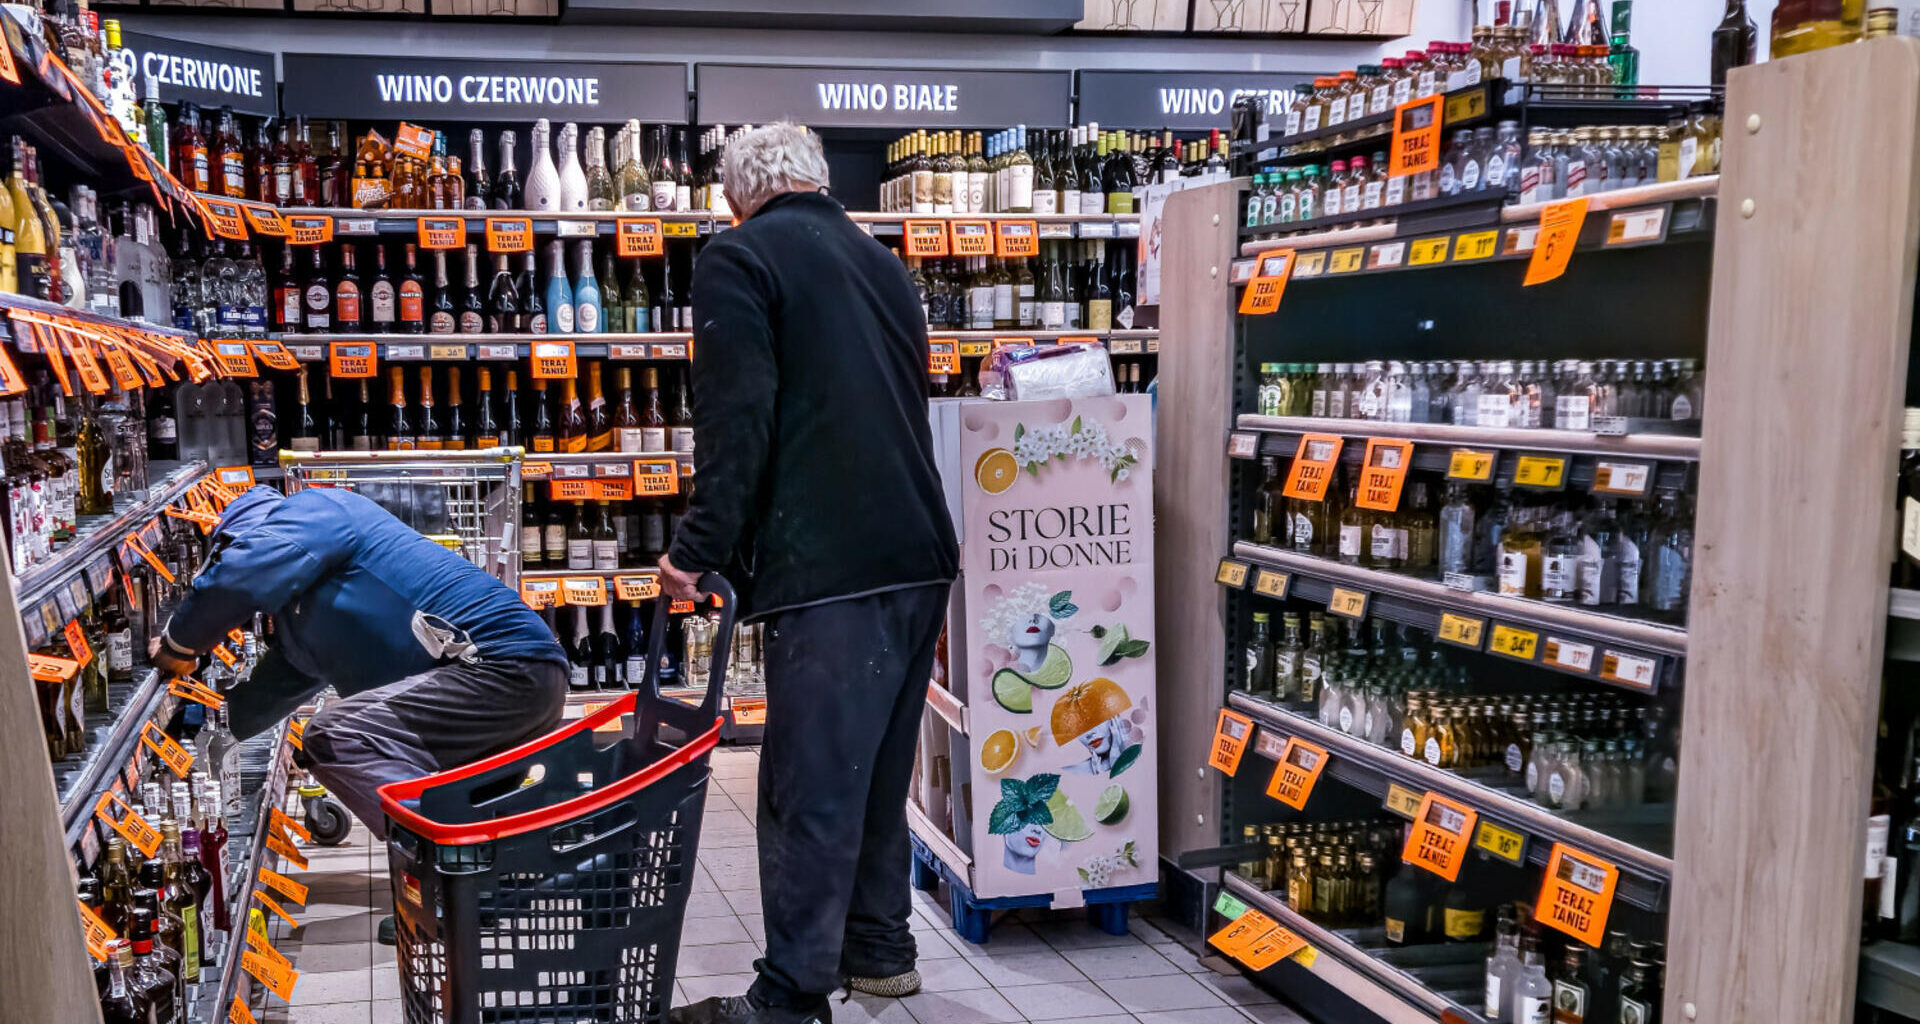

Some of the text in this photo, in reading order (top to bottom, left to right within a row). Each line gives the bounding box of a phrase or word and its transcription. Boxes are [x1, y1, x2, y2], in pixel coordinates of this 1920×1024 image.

[143, 52, 263, 97] CZERWONE
[377, 75, 599, 104] WINO CZERWONE
[818, 83, 958, 111] WINO BIAŁE
[1160, 88, 1225, 115] WINO
[643, 476, 669, 484] TERAZ
[644, 484, 670, 492] TANIEJ
[988, 503, 1131, 542] STORIE
[991, 540, 1131, 571] Di DONNE
[1557, 886, 1594, 915] TERAZ
[1552, 904, 1590, 933] TANIEJ
